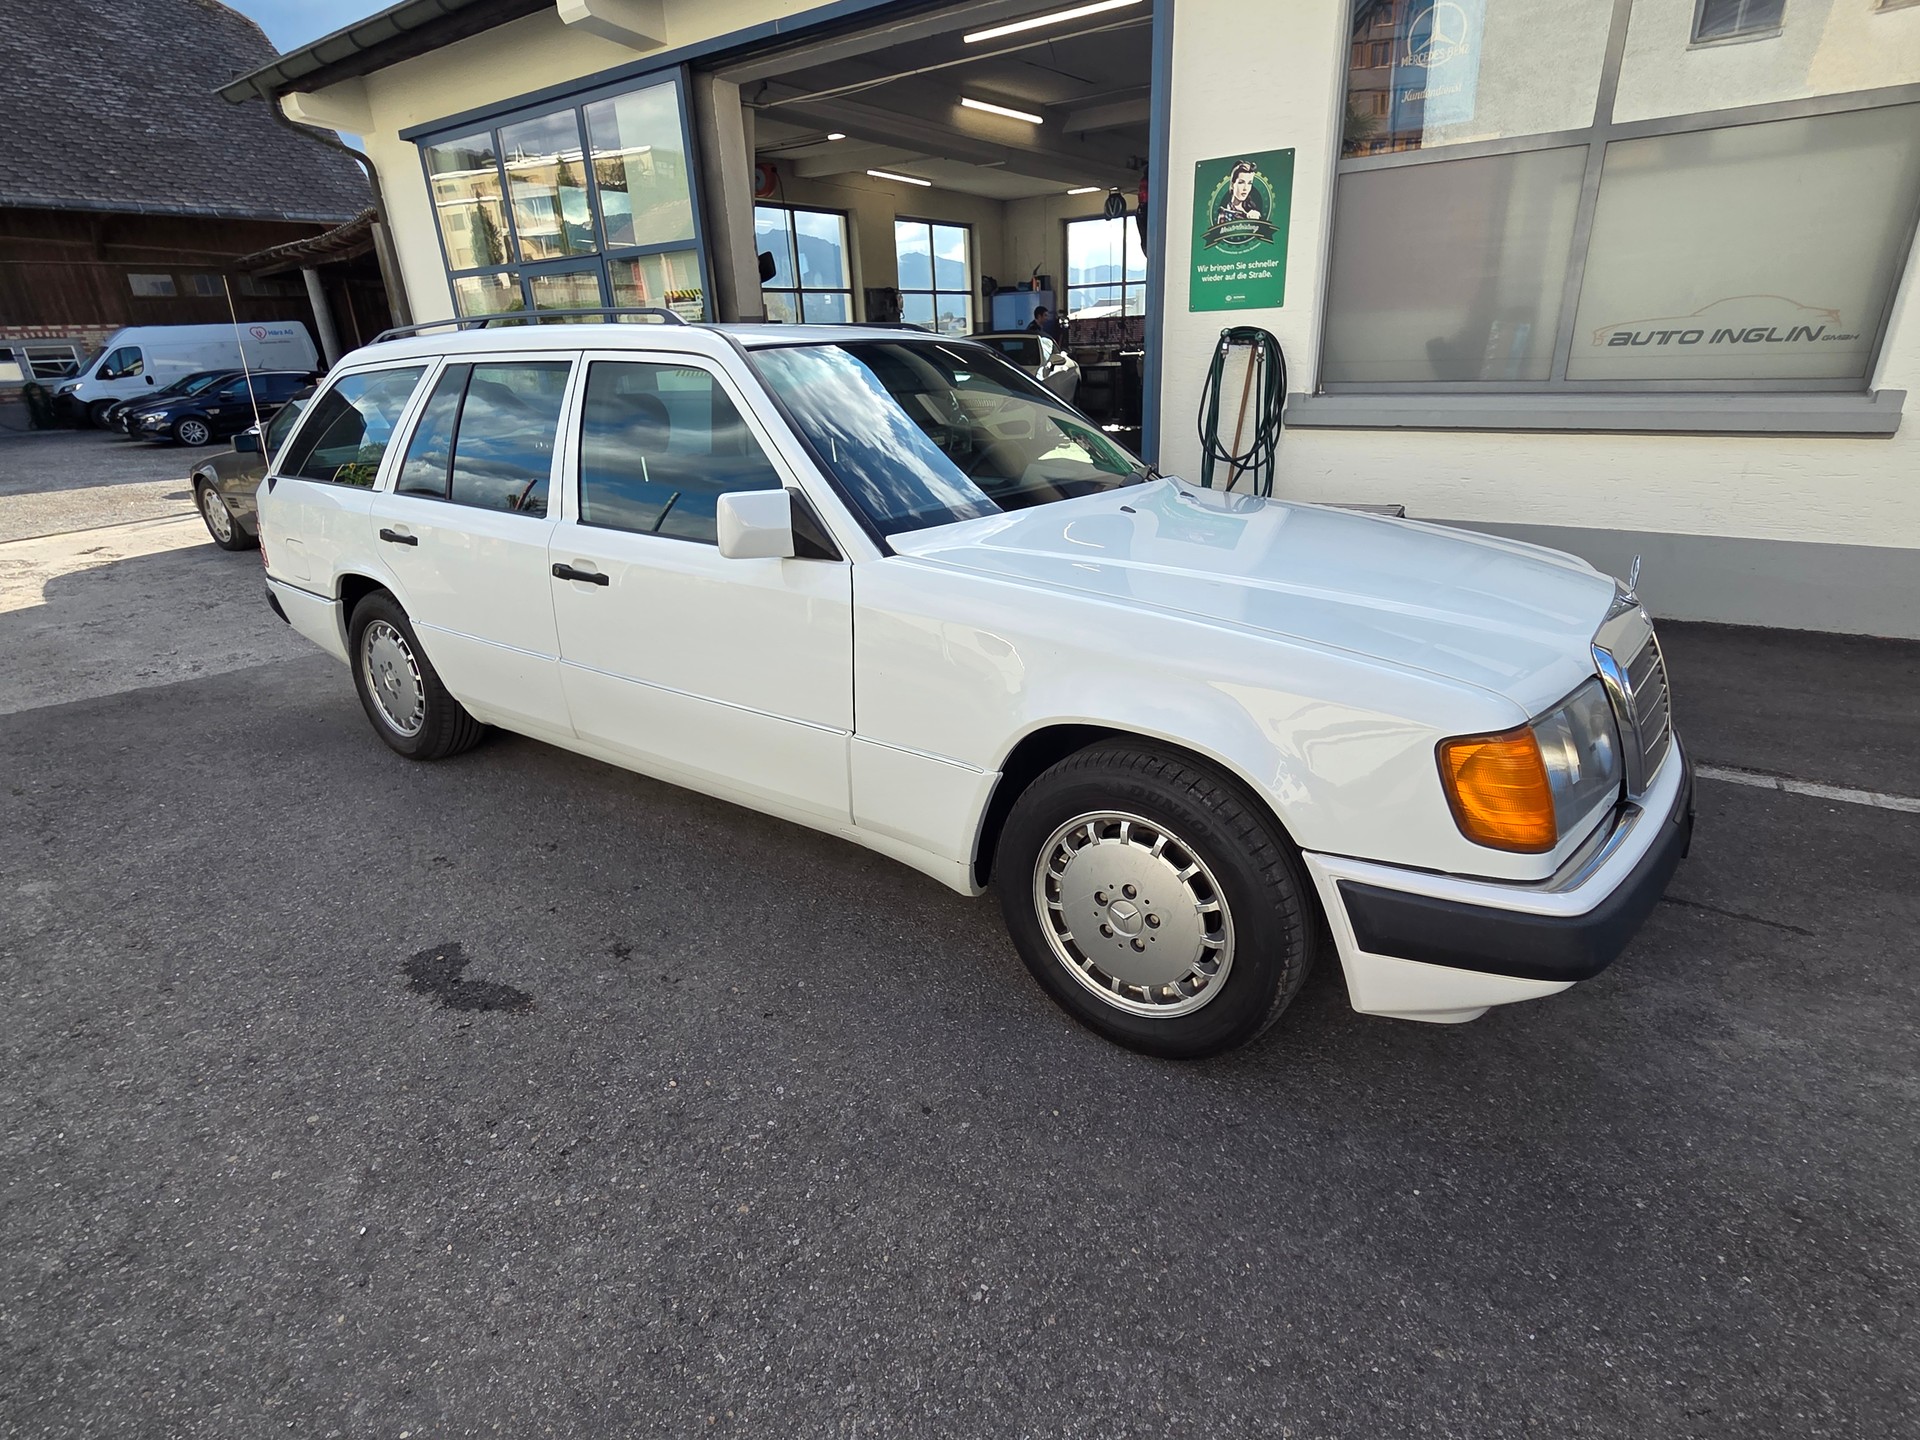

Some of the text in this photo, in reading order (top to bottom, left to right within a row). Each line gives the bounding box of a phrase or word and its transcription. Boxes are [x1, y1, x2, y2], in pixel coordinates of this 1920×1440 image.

[1197, 259, 1279, 273] Wir bringen Sie schneller
[1201, 269, 1273, 282] wieder auf die Straße.
[1608, 329, 1704, 346] AUTO
[1708, 325, 1826, 344] INGLIN
